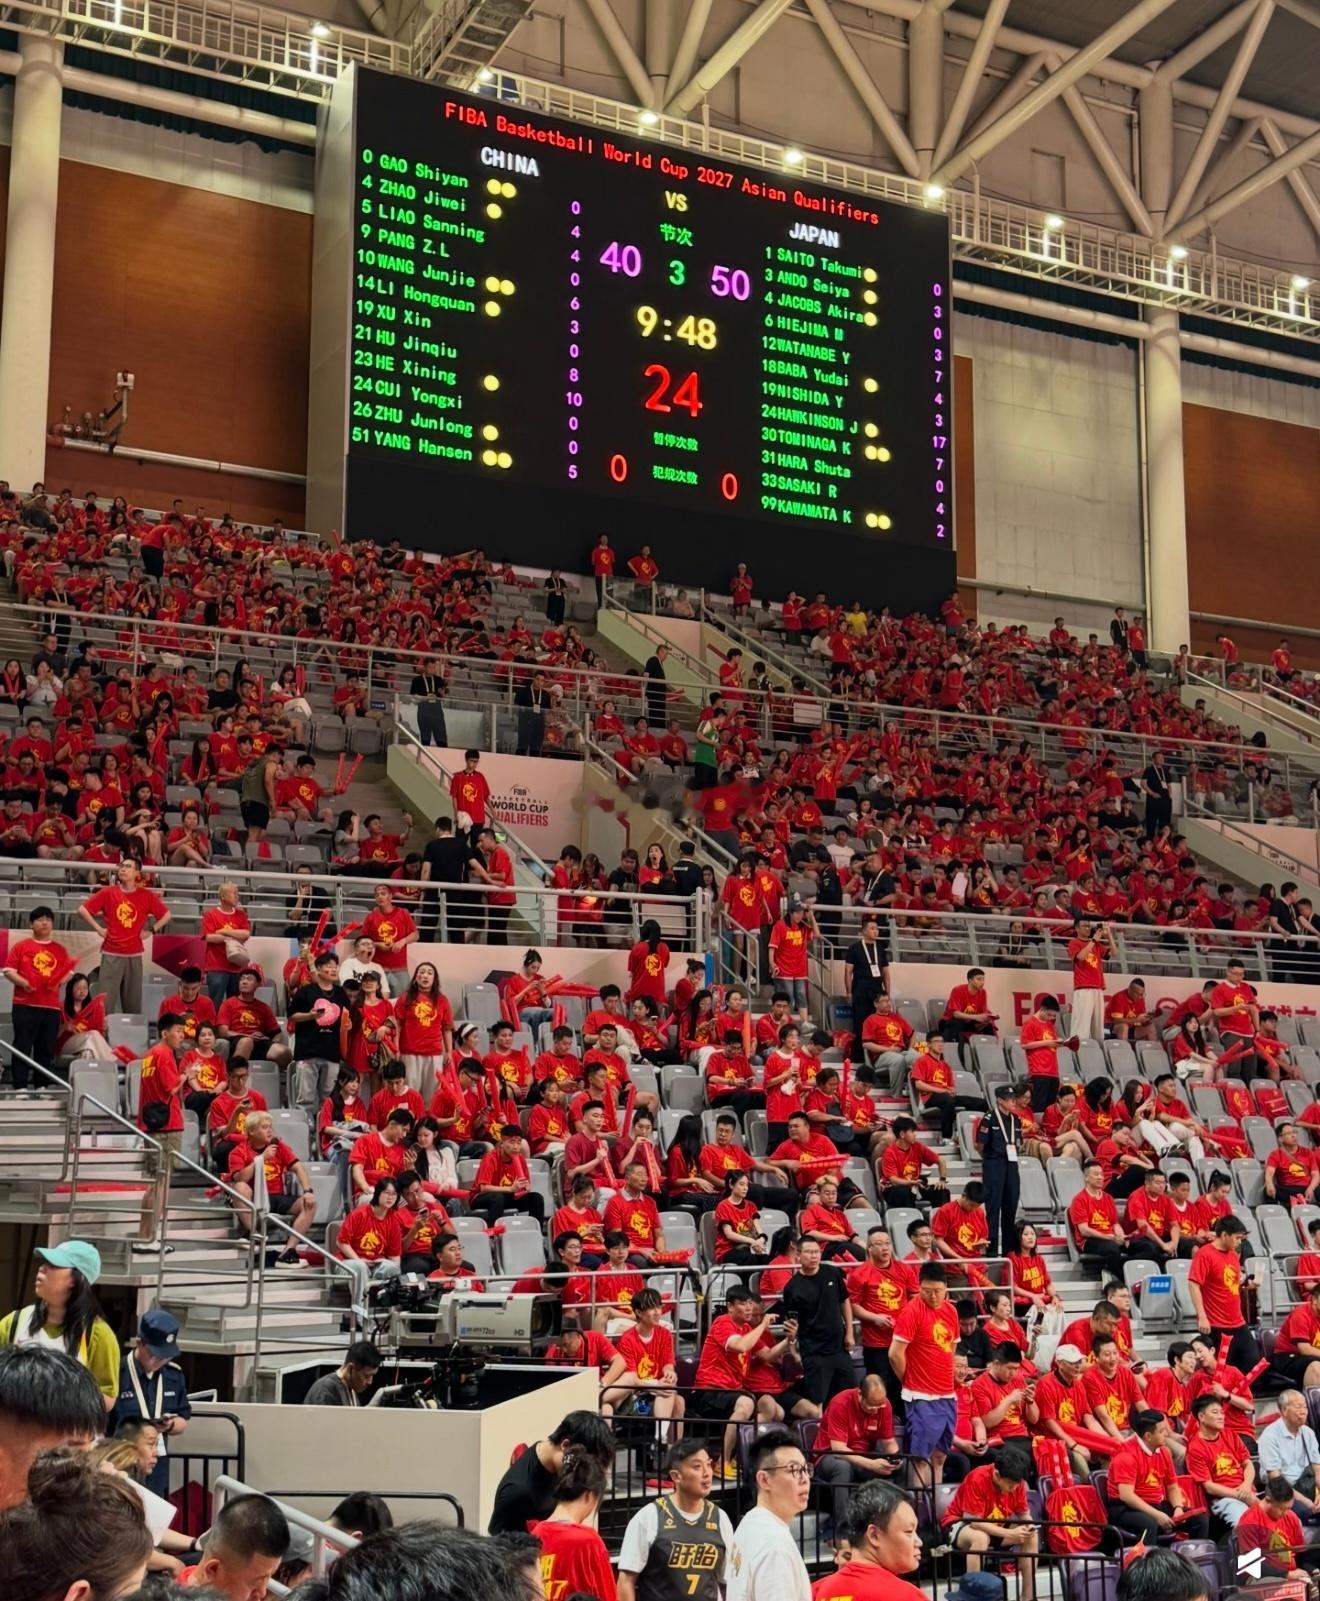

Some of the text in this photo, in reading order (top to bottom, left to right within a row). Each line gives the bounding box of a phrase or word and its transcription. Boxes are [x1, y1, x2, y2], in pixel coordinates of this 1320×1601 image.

[363, 149, 469, 188] 0 GAO Shiyan
[444, 103, 879, 224] FIBA Basketball World Cup 2027 Asian Qualifiers
[480, 146, 539, 176] CHINA
[362, 175, 466, 212] 4 ZHAO Jiwei
[665, 191, 688, 211] VS
[572, 201, 580, 215] 0
[362, 200, 485, 242] 5 LIAO Sanning
[361, 224, 450, 258] 9 PANG Z.L
[571, 226, 581, 238] 4
[660, 223, 694, 246] 节次
[789, 223, 840, 248] JAPAN
[571, 250, 580, 262] 4
[600, 242, 641, 277] 40
[766, 247, 862, 278] 1 SAITO Takumi
[357, 249, 475, 287] 10 WANG Junjie
[669, 261, 685, 284] 3
[571, 273, 580, 286] 0
[711, 266, 750, 300] 50
[765, 269, 849, 298] 3 ANDO Seiya
[357, 274, 475, 312] 14 LI Hongquan
[934, 284, 941, 296] 0
[571, 297, 580, 310] 6
[765, 292, 864, 323] 4 JACOBS Akira
[934, 306, 941, 318] 3
[356, 300, 431, 328] 19 XU Xin
[571, 321, 579, 334] 3
[637, 306, 716, 350] 9:48
[765, 315, 843, 341] 6 HIEJIMA M
[934, 328, 941, 340] 0
[355, 325, 457, 358] 21 HU Jinqiu
[570, 344, 579, 358] 0
[842, 352, 850, 365] Y
[935, 349, 942, 361] 3
[355, 350, 456, 385] 23 HE Xining
[570, 369, 579, 382] 8
[814, 368, 848, 387] Yudai
[935, 371, 942, 383] 7
[354, 376, 461, 408] 24 CUI Yongxi
[566, 392, 582, 406] 10
[645, 364, 703, 417] 24
[935, 393, 942, 404] 4
[836, 395, 843, 408] Y
[354, 401, 472, 438] 26 ZHU Junlong
[569, 417, 578, 430] 0
[850, 421, 858, 433] J
[936, 414, 942, 426] 3
[352, 427, 472, 461] 51 YANG Hansen
[569, 441, 577, 454] 0
[654, 432, 698, 451] 暂停次数
[842, 441, 851, 455] K
[933, 436, 946, 448] 17
[569, 465, 577, 478] 5
[611, 454, 627, 481] 0
[814, 460, 850, 478] Shuta
[936, 458, 943, 470] 7
[653, 466, 698, 484] 犯规次数
[722, 473, 737, 500] 0
[829, 484, 836, 497] R
[936, 481, 943, 492] 0
[843, 510, 851, 523] K
[937, 503, 944, 515] 4
[937, 525, 944, 537] 2
[491, 800, 549, 814] WORLD CUP
[494, 811, 549, 827] UALIFIERS
[668, 1541, 719, 1569] 盱眙
[686, 1573, 700, 1595] 7
